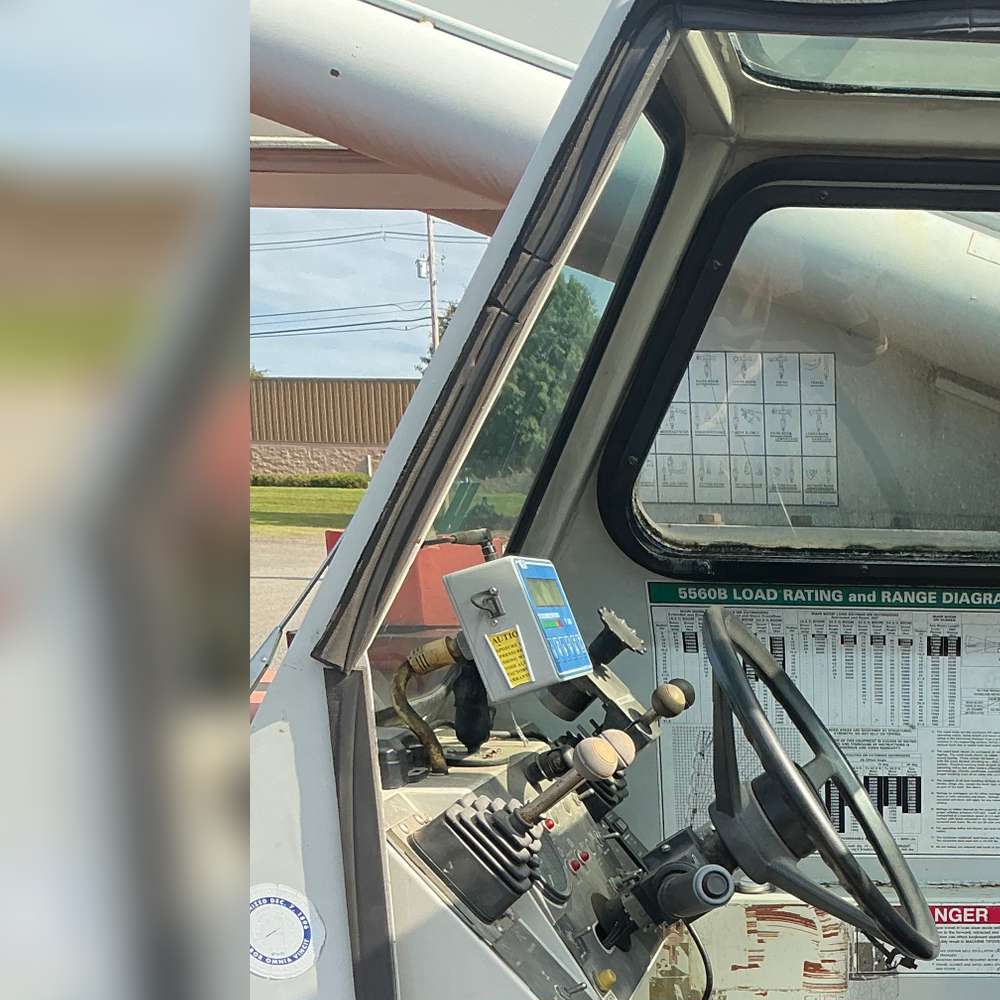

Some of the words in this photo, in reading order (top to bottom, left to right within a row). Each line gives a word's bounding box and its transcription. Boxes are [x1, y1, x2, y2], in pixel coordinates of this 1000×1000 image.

[678, 588, 727, 600] 5560B
[733, 588, 778, 600] LOAD
[784, 589, 843, 601] RATING
[848, 591, 876, 602] and
[881, 592, 936, 603] RANGE
[934, 908, 988, 922] NGER
